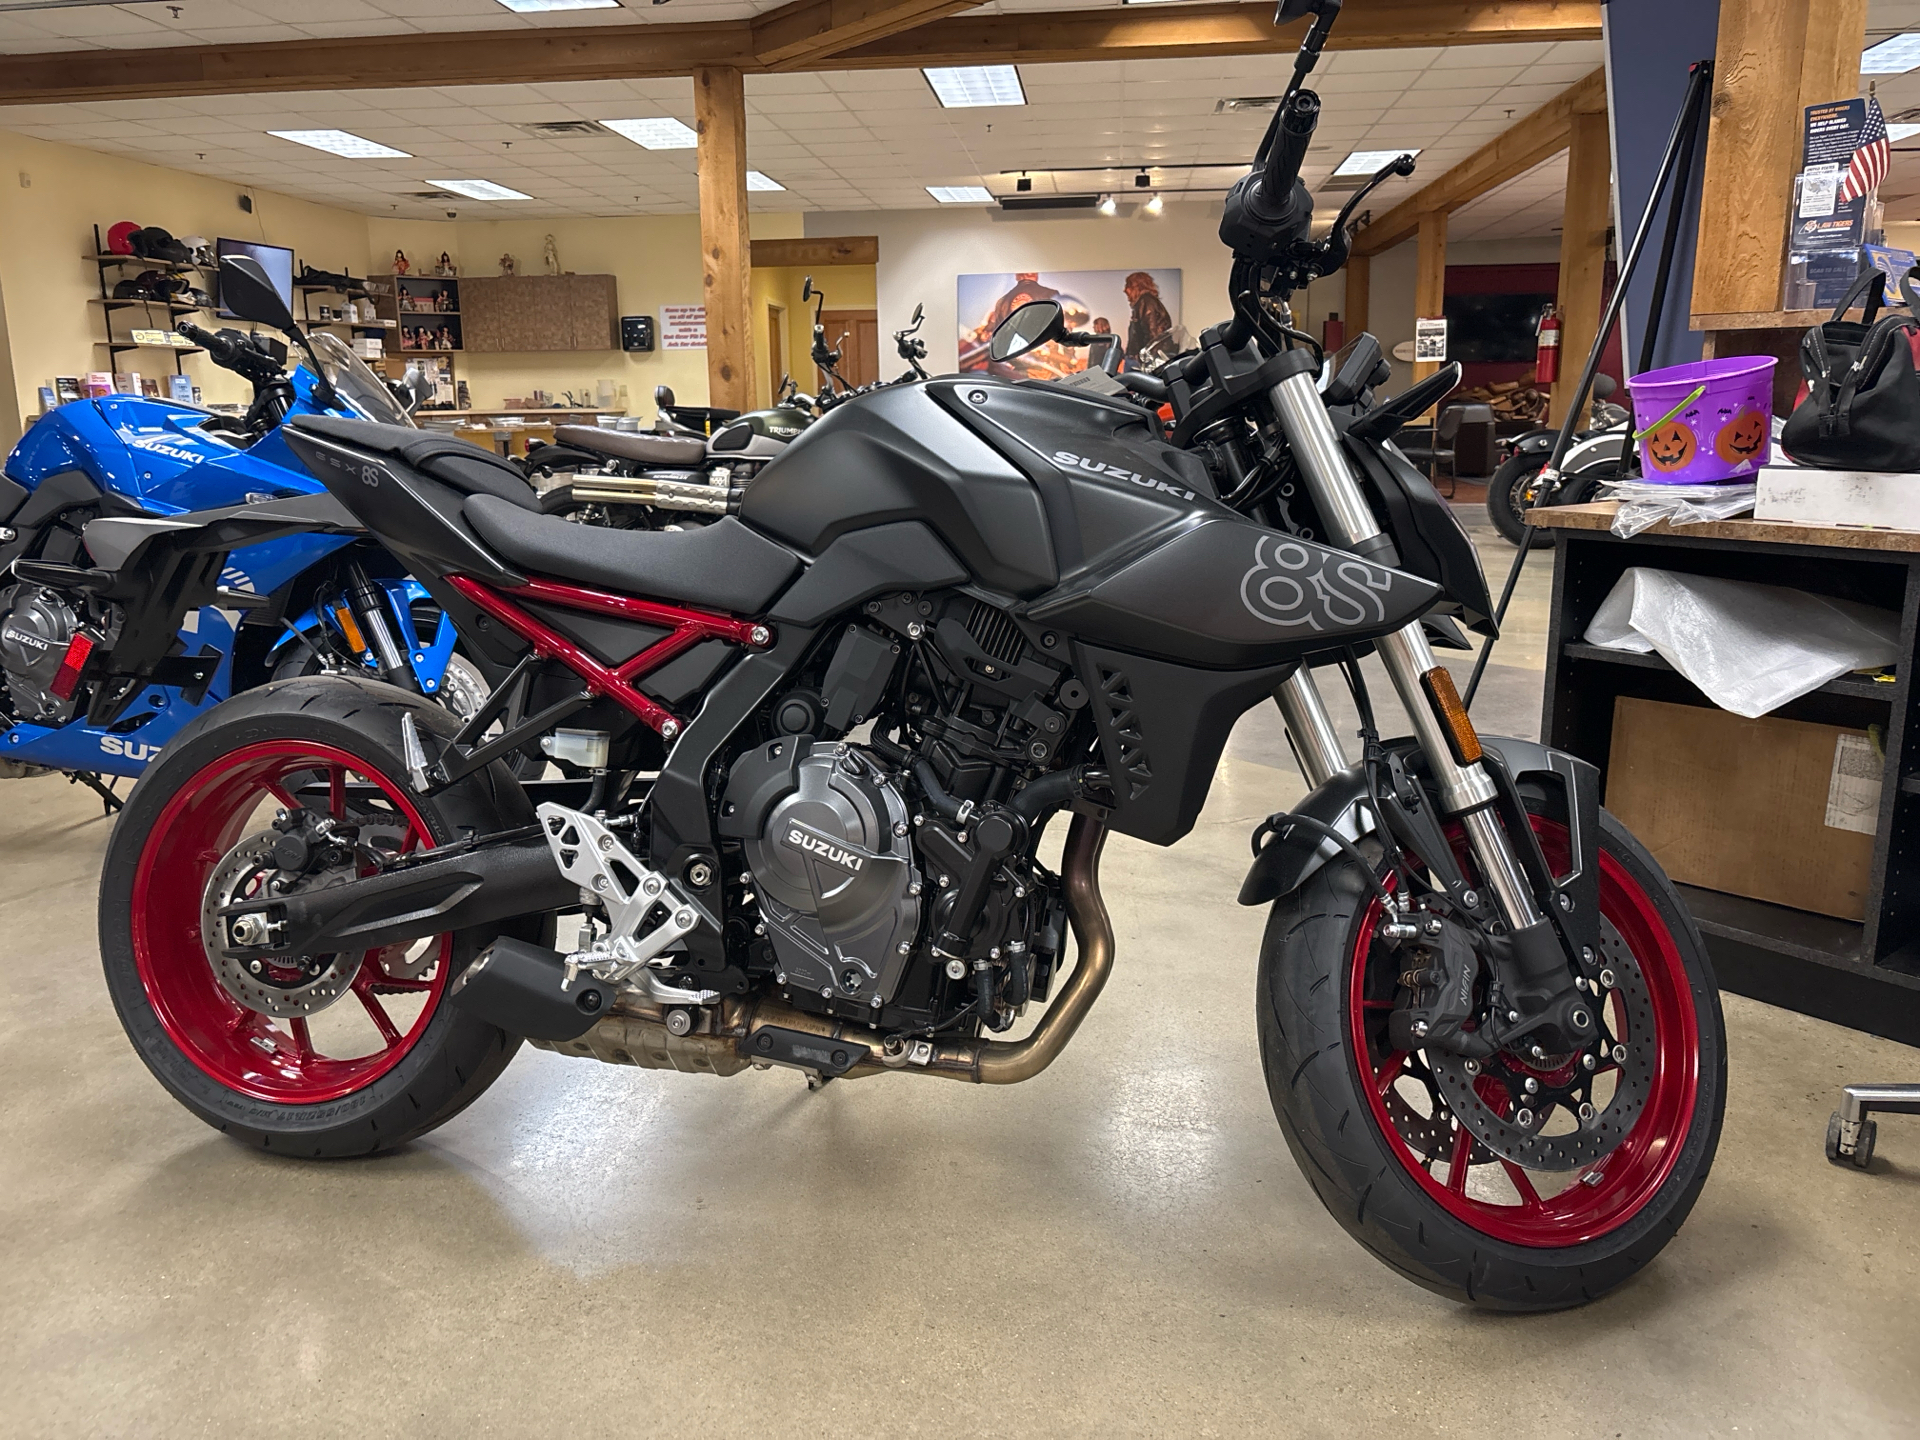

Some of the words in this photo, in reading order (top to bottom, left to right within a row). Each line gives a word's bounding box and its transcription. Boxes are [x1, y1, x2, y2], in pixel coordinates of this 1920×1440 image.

[1832, 220, 1854, 228] TIGERS
[133, 440, 205, 464] SUZUKI
[361, 465, 380, 488] 8S
[1052, 450, 1196, 501] SUZUKI
[6, 629, 49, 651] SUZUKI
[100, 736, 163, 762] SUZ
[788, 829, 864, 872] SUZUKI
